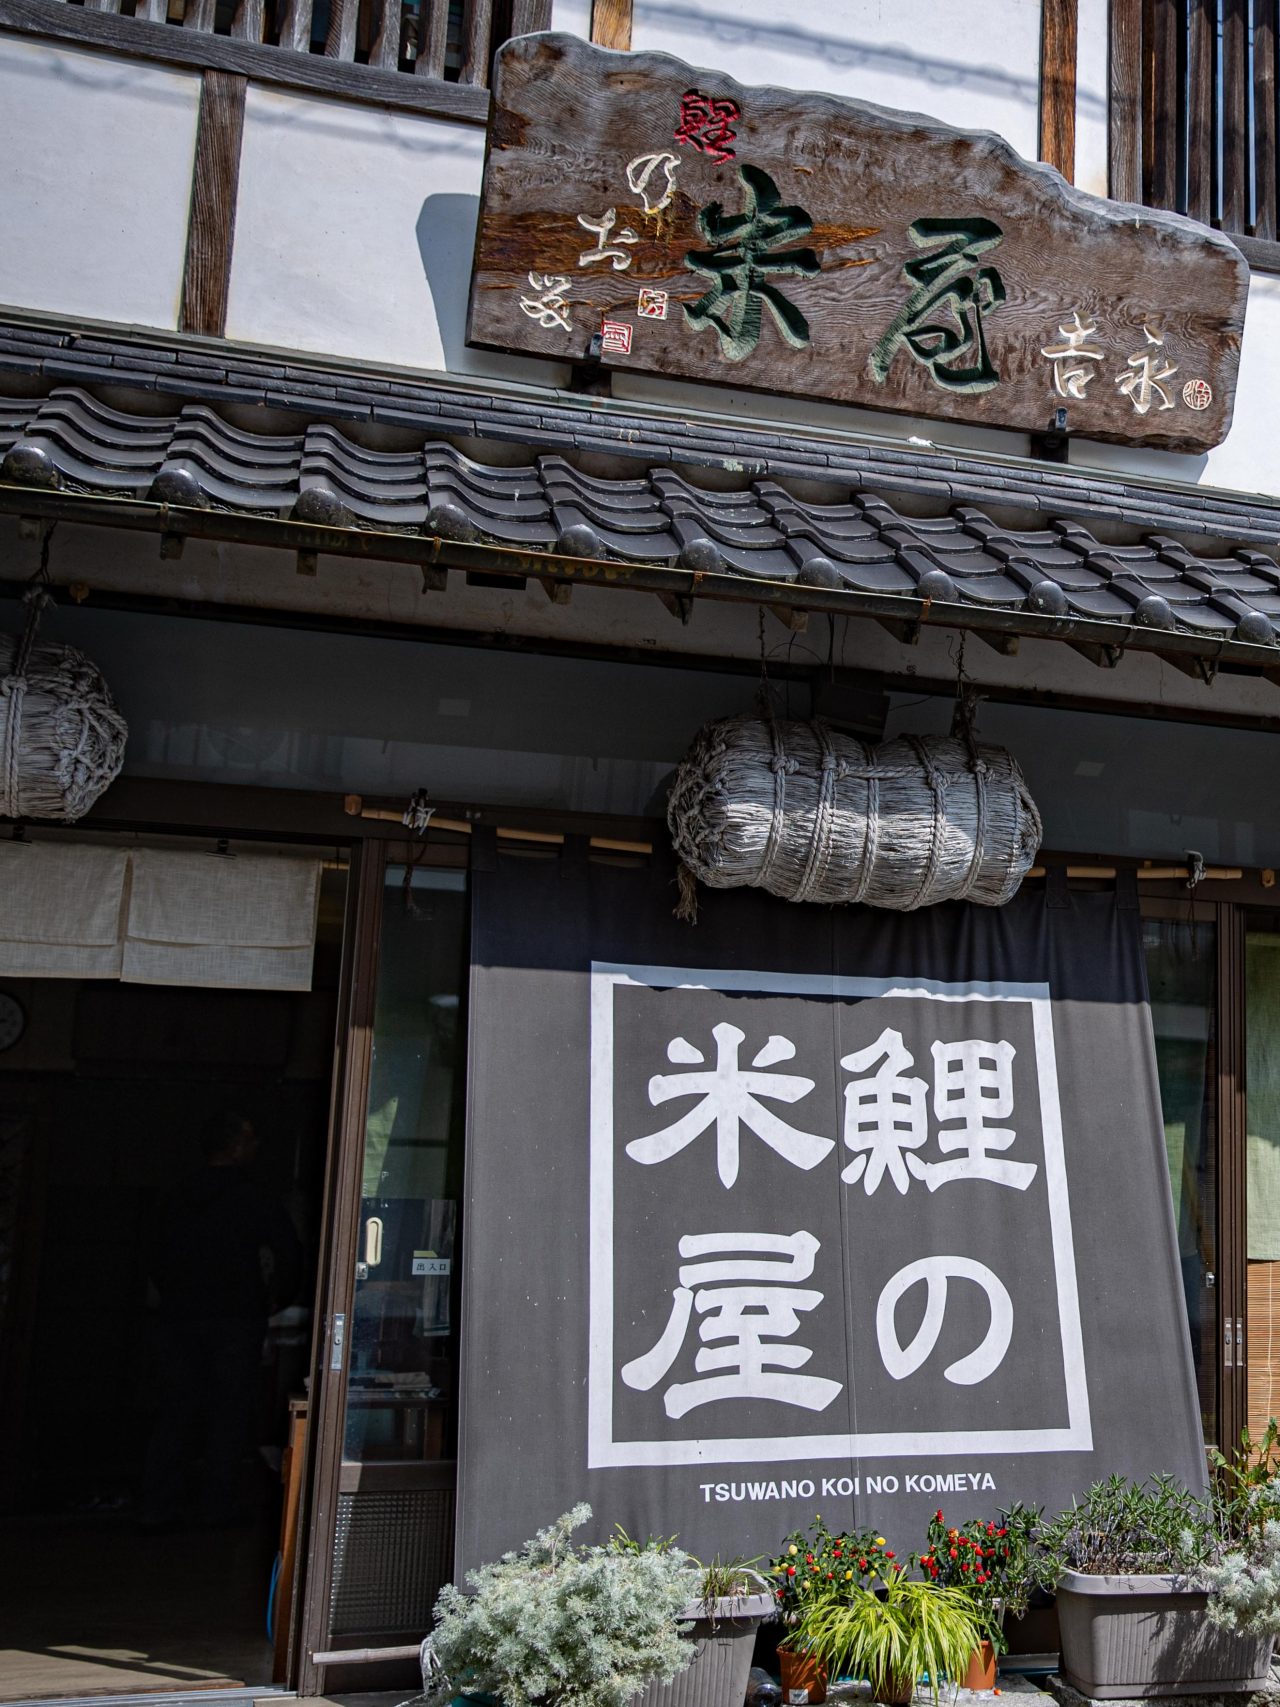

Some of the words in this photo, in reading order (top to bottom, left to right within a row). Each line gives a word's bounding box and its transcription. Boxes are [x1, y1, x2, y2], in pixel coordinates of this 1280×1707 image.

[416, 1263, 447, 1271] 出入口
[700, 1479, 815, 1503] TSUWANO
[821, 1477, 860, 1497] KOI
[866, 1475, 899, 1494] NO
[905, 1472, 996, 1493] KOMEYA
